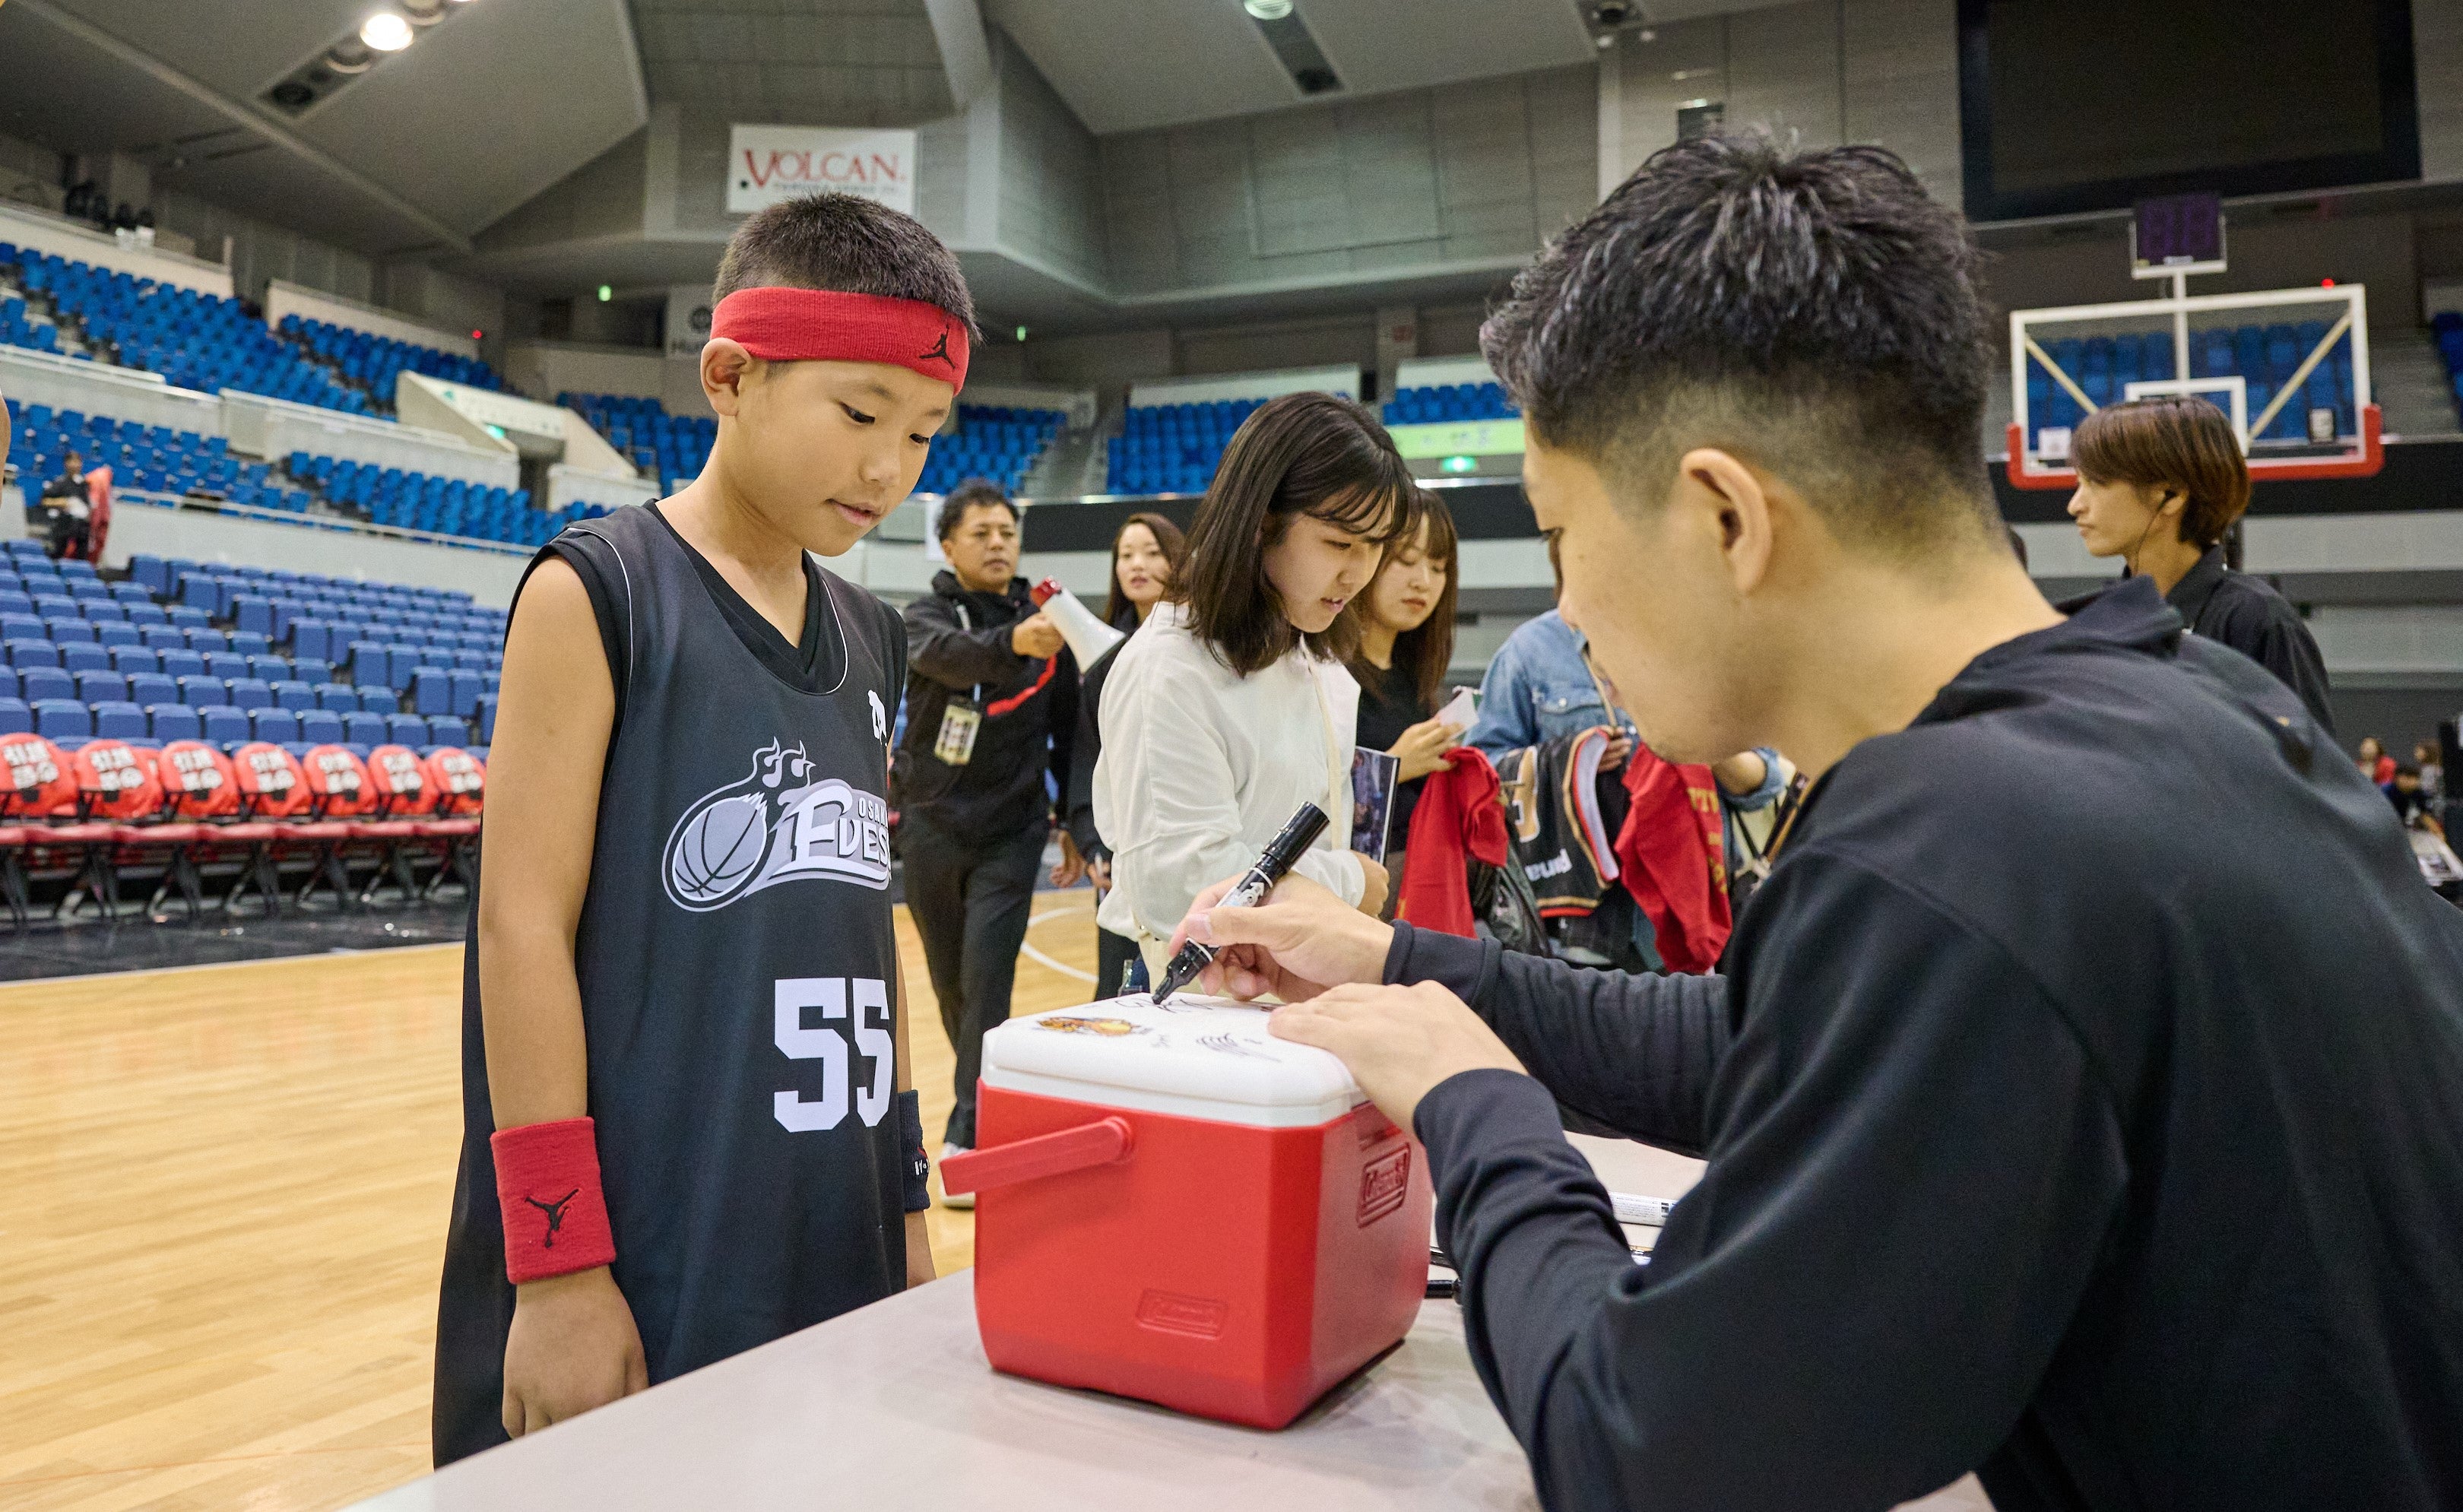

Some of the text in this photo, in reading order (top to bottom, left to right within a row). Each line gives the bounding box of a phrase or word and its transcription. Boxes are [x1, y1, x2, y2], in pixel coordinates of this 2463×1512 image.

[778, 785, 890, 876] EVES
[857, 797, 888, 829] OSAK
[774, 977, 893, 1133] 55
